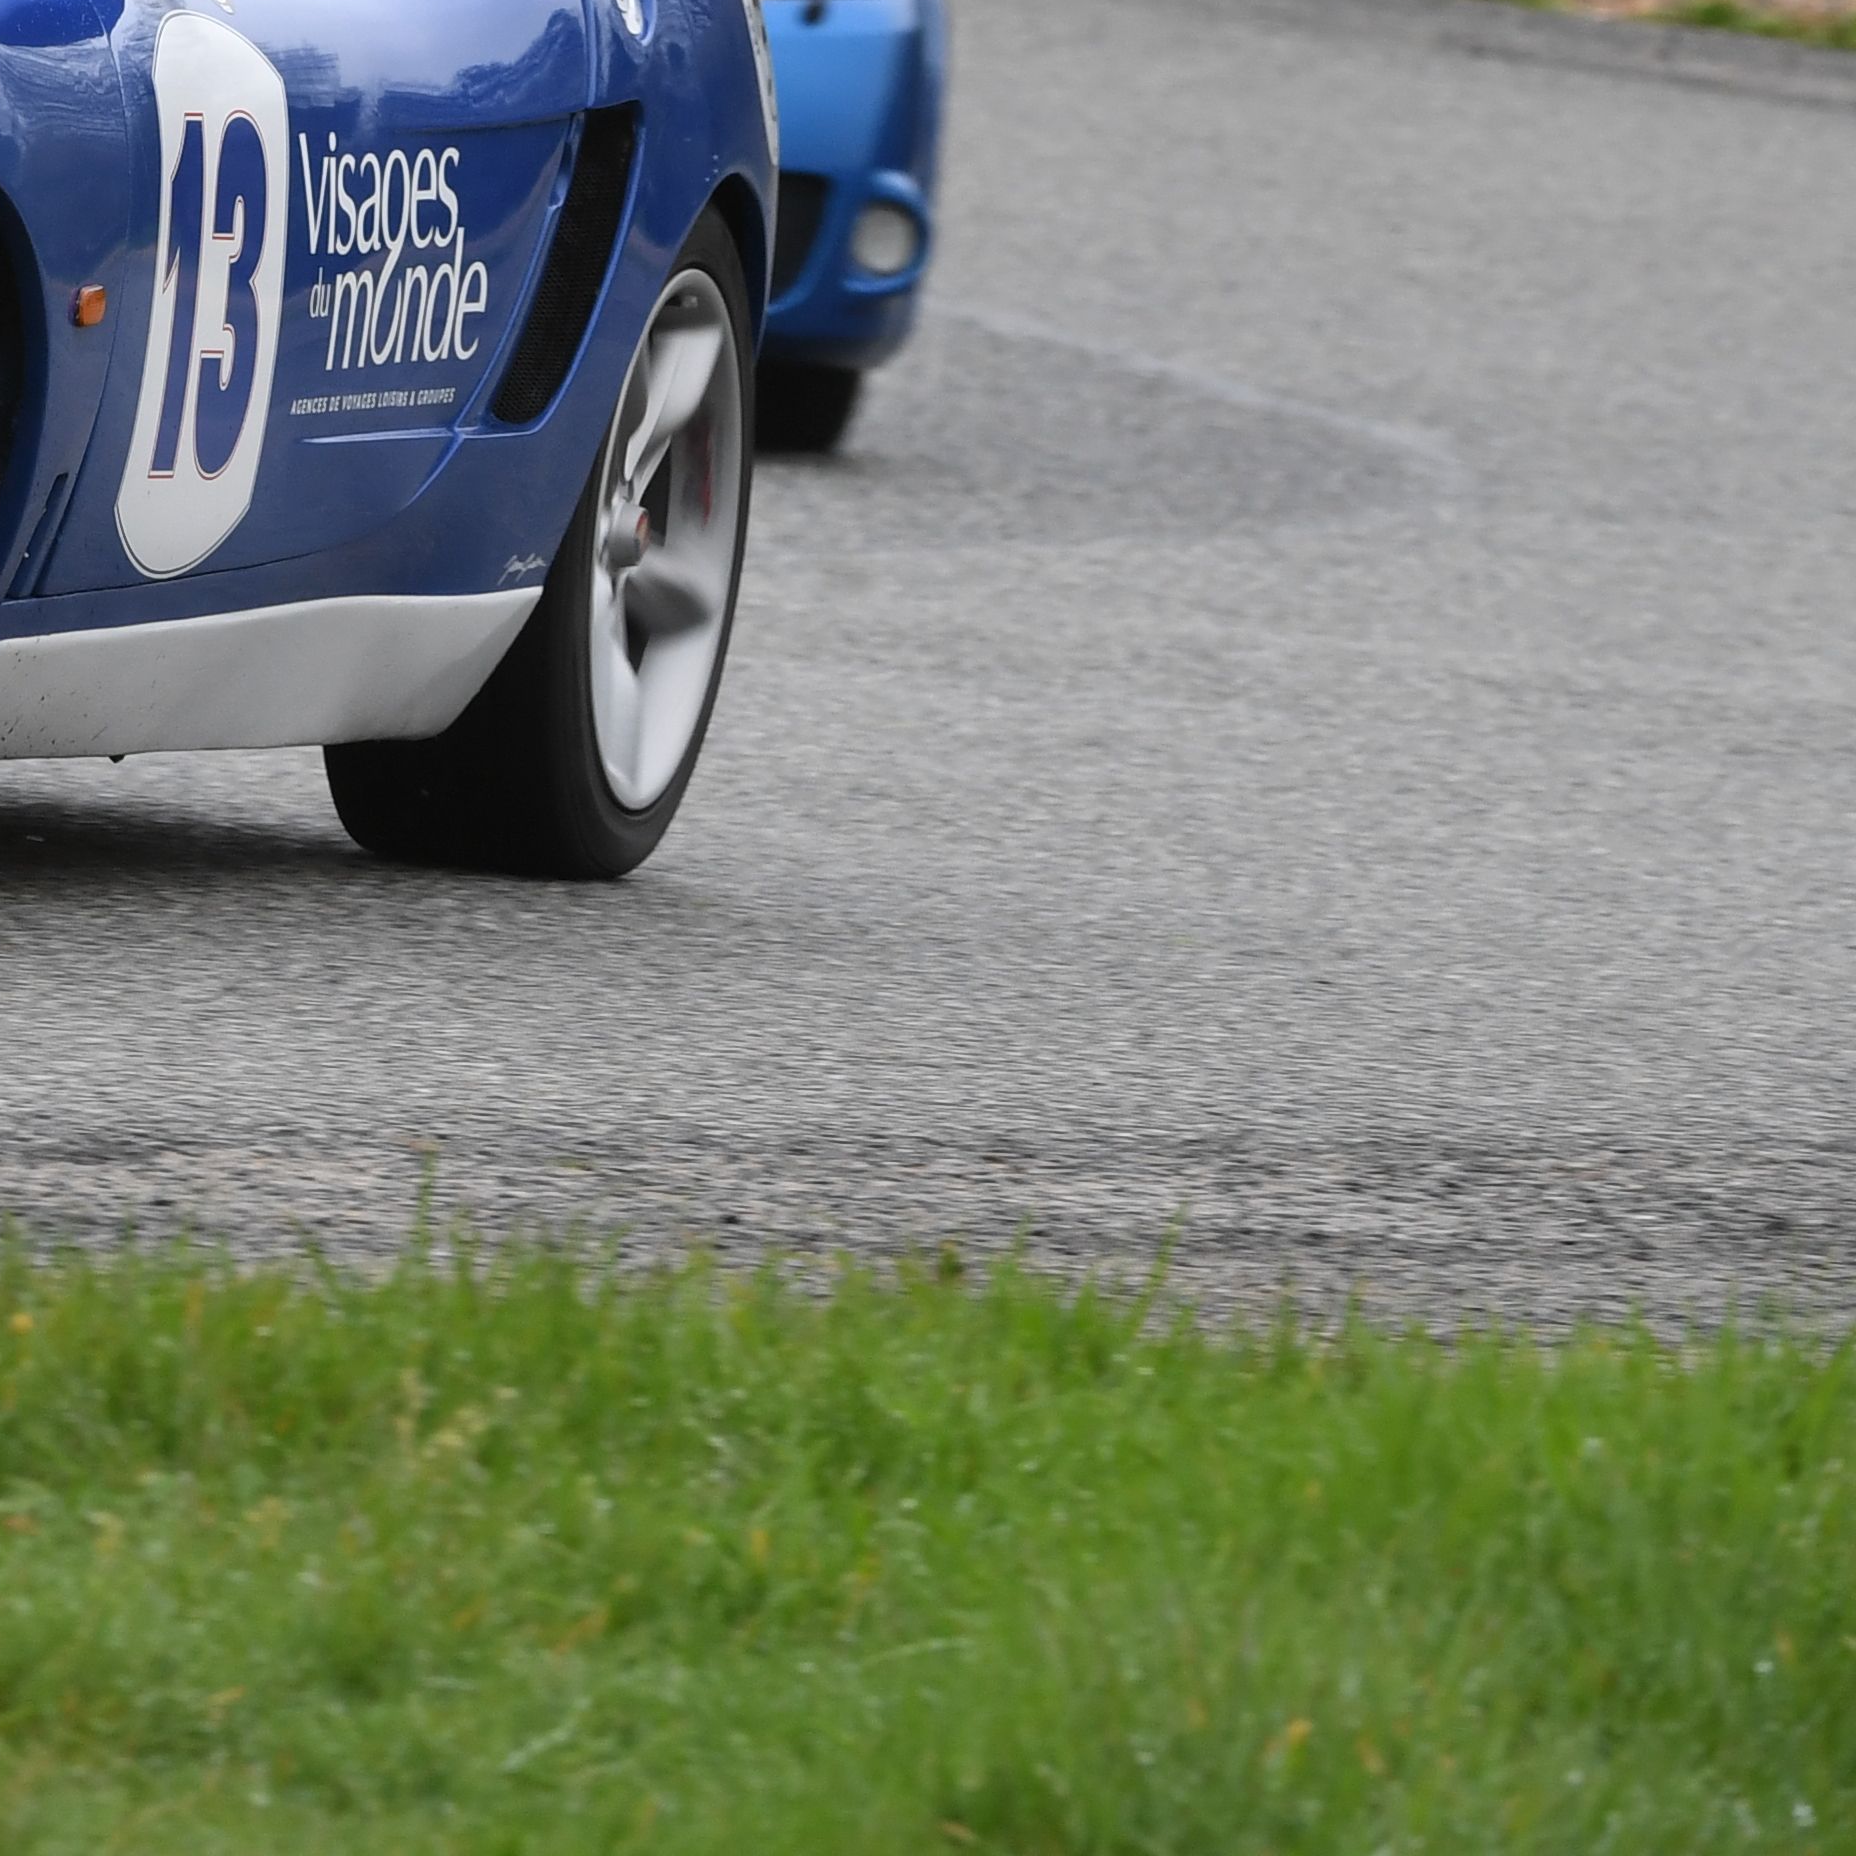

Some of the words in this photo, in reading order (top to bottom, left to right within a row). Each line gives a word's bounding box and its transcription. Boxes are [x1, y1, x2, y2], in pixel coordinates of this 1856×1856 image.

[298, 131, 460, 272] Visages
[148, 110, 269, 481] 13
[309, 266, 332, 319] du
[326, 226, 488, 371] monde
[290, 396, 328, 415] AGENCES
[328, 395, 341, 412] DE
[342, 392, 377, 411] VOYAGES
[378, 390, 409, 408] LOISIRS
[417, 387, 456, 405] GROUPES
